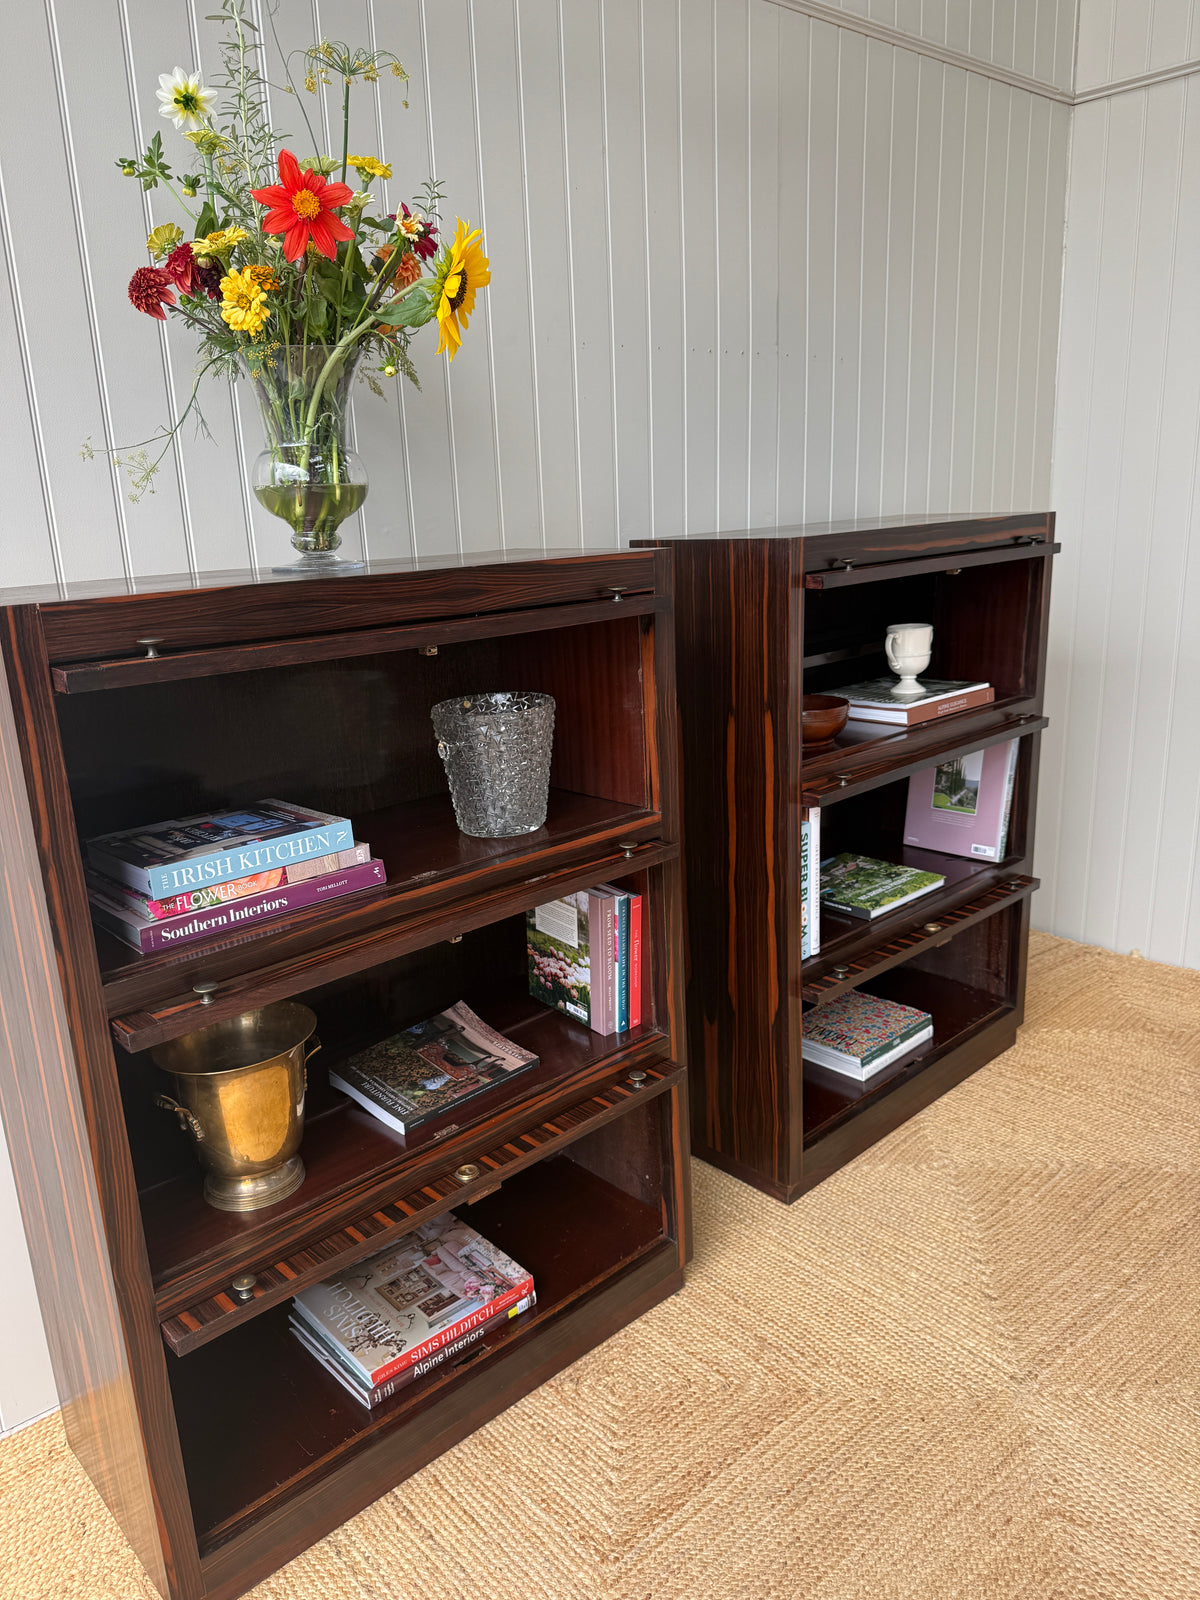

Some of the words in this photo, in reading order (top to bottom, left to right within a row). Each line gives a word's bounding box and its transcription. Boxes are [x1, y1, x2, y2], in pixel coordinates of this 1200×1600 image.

[161, 873, 169, 890] THE
[171, 857, 232, 888] IRISH
[240, 832, 331, 871] KITCHEN
[162, 902, 175, 911] THE
[176, 884, 237, 911] FLOWER
[238, 881, 257, 891] BOOK
[161, 915, 228, 942] Southern
[229, 897, 288, 923] Interiors
[606, 946, 612, 956] TO
[361, 1081, 399, 1111] FURNITURE
[324, 1305, 363, 1339] SIMS
[327, 1282, 396, 1344] HILDITCH
[410, 1339, 440, 1364] SIMS
[441, 1305, 495, 1346] HILDITCH
[413, 1354, 445, 1378] Alpine
[445, 1327, 485, 1358] Interiors
